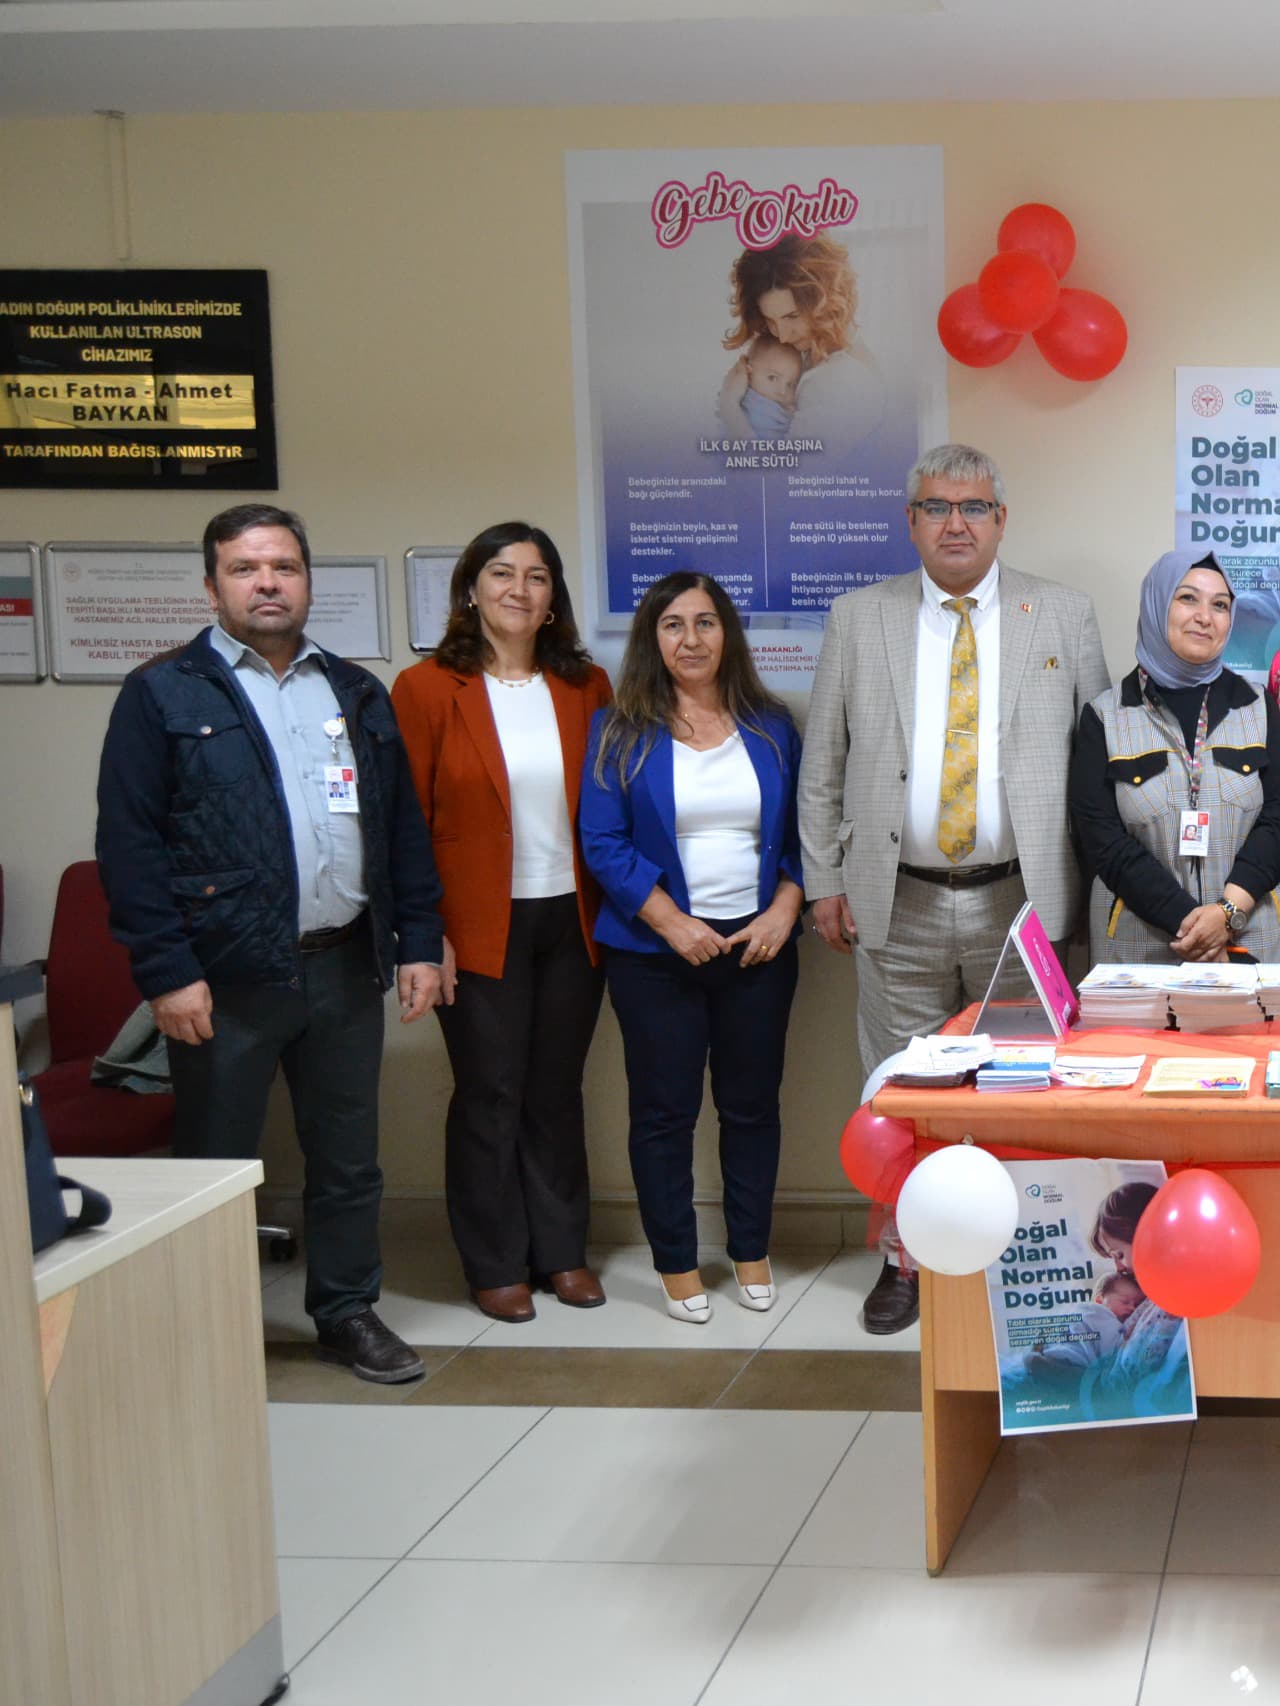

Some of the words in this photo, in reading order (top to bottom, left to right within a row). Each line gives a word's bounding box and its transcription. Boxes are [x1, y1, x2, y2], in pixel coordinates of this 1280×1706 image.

[653, 174, 749, 247] Gebe
[739, 180, 856, 249] Okulu
[0, 302, 33, 316] ADIN
[36, 300, 86, 316] DOĞUM
[88, 300, 242, 316] POLİKLİNİKLERİMİZDE
[30, 325, 124, 339] KULLANILAN
[126, 325, 202, 339] ULTRASON
[81, 346, 153, 362] CİHAZIMIZ
[7, 382, 57, 398] Hacı
[66, 382, 136, 398] Fatma
[159, 382, 233, 398] Ahmet
[72, 405, 169, 422] BAYKAN
[700, 438, 720, 451] İLK
[722, 440, 730, 452] 6
[732, 440, 747, 451] AY
[751, 439, 775, 451] TEK
[778, 439, 823, 453] BAŞINA
[1191, 435, 1276, 464] Doğal
[4, 445, 104, 458] TARAFINDAN
[726, 456, 760, 468] ANNE
[762, 453, 800, 468] SÜTÜ!
[859, 477, 870, 485] ve
[1191, 464, 1260, 487] Olan
[628, 477, 679, 488] Bebeğinizle
[681, 476, 727, 486] aranızdaki
[629, 489, 648, 500] bağı
[649, 489, 693, 500] güçlendir.
[789, 488, 854, 498] enfeksiyonlara
[856, 488, 877, 498] karşı
[879, 487, 905, 497] korur.
[630, 522, 682, 533] Bebeğinizin
[683, 522, 709, 533] beyin,
[711, 522, 726, 531] kas
[728, 523, 738, 531] ve
[790, 521, 813, 530] Anne
[814, 521, 834, 530] sütü
[848, 521, 889, 530] beslenen
[661, 534, 694, 543] sistemi
[695, 534, 738, 545] gelişimini
[790, 533, 826, 544] bebeğin
[838, 533, 869, 544] yüksek
[871, 533, 888, 542] olur
[631, 546, 675, 556] destekler.
[1220, 556, 1242, 566] larak
[1244, 557, 1279, 566] zorunlu
[791, 572, 843, 583] Bebeğinizin
[844, 572, 855, 581] ilk
[856, 572, 862, 581] 6
[863, 574, 874, 582] ay
[1231, 568, 1260, 577] sürece
[743, 586, 753, 594] ve
[825, 585, 844, 593] olan
[791, 598, 816, 606] besin
[145, 616, 178, 624] HALLER
[122, 639, 153, 648] HASTA
[88, 652, 123, 660] KABUL
[1014, 1218, 1067, 1244] oğal
[1000, 1244, 1057, 1265] Olan
[1001, 1261, 1093, 1287] Normal
[1004, 1287, 1093, 1311] Doğum
